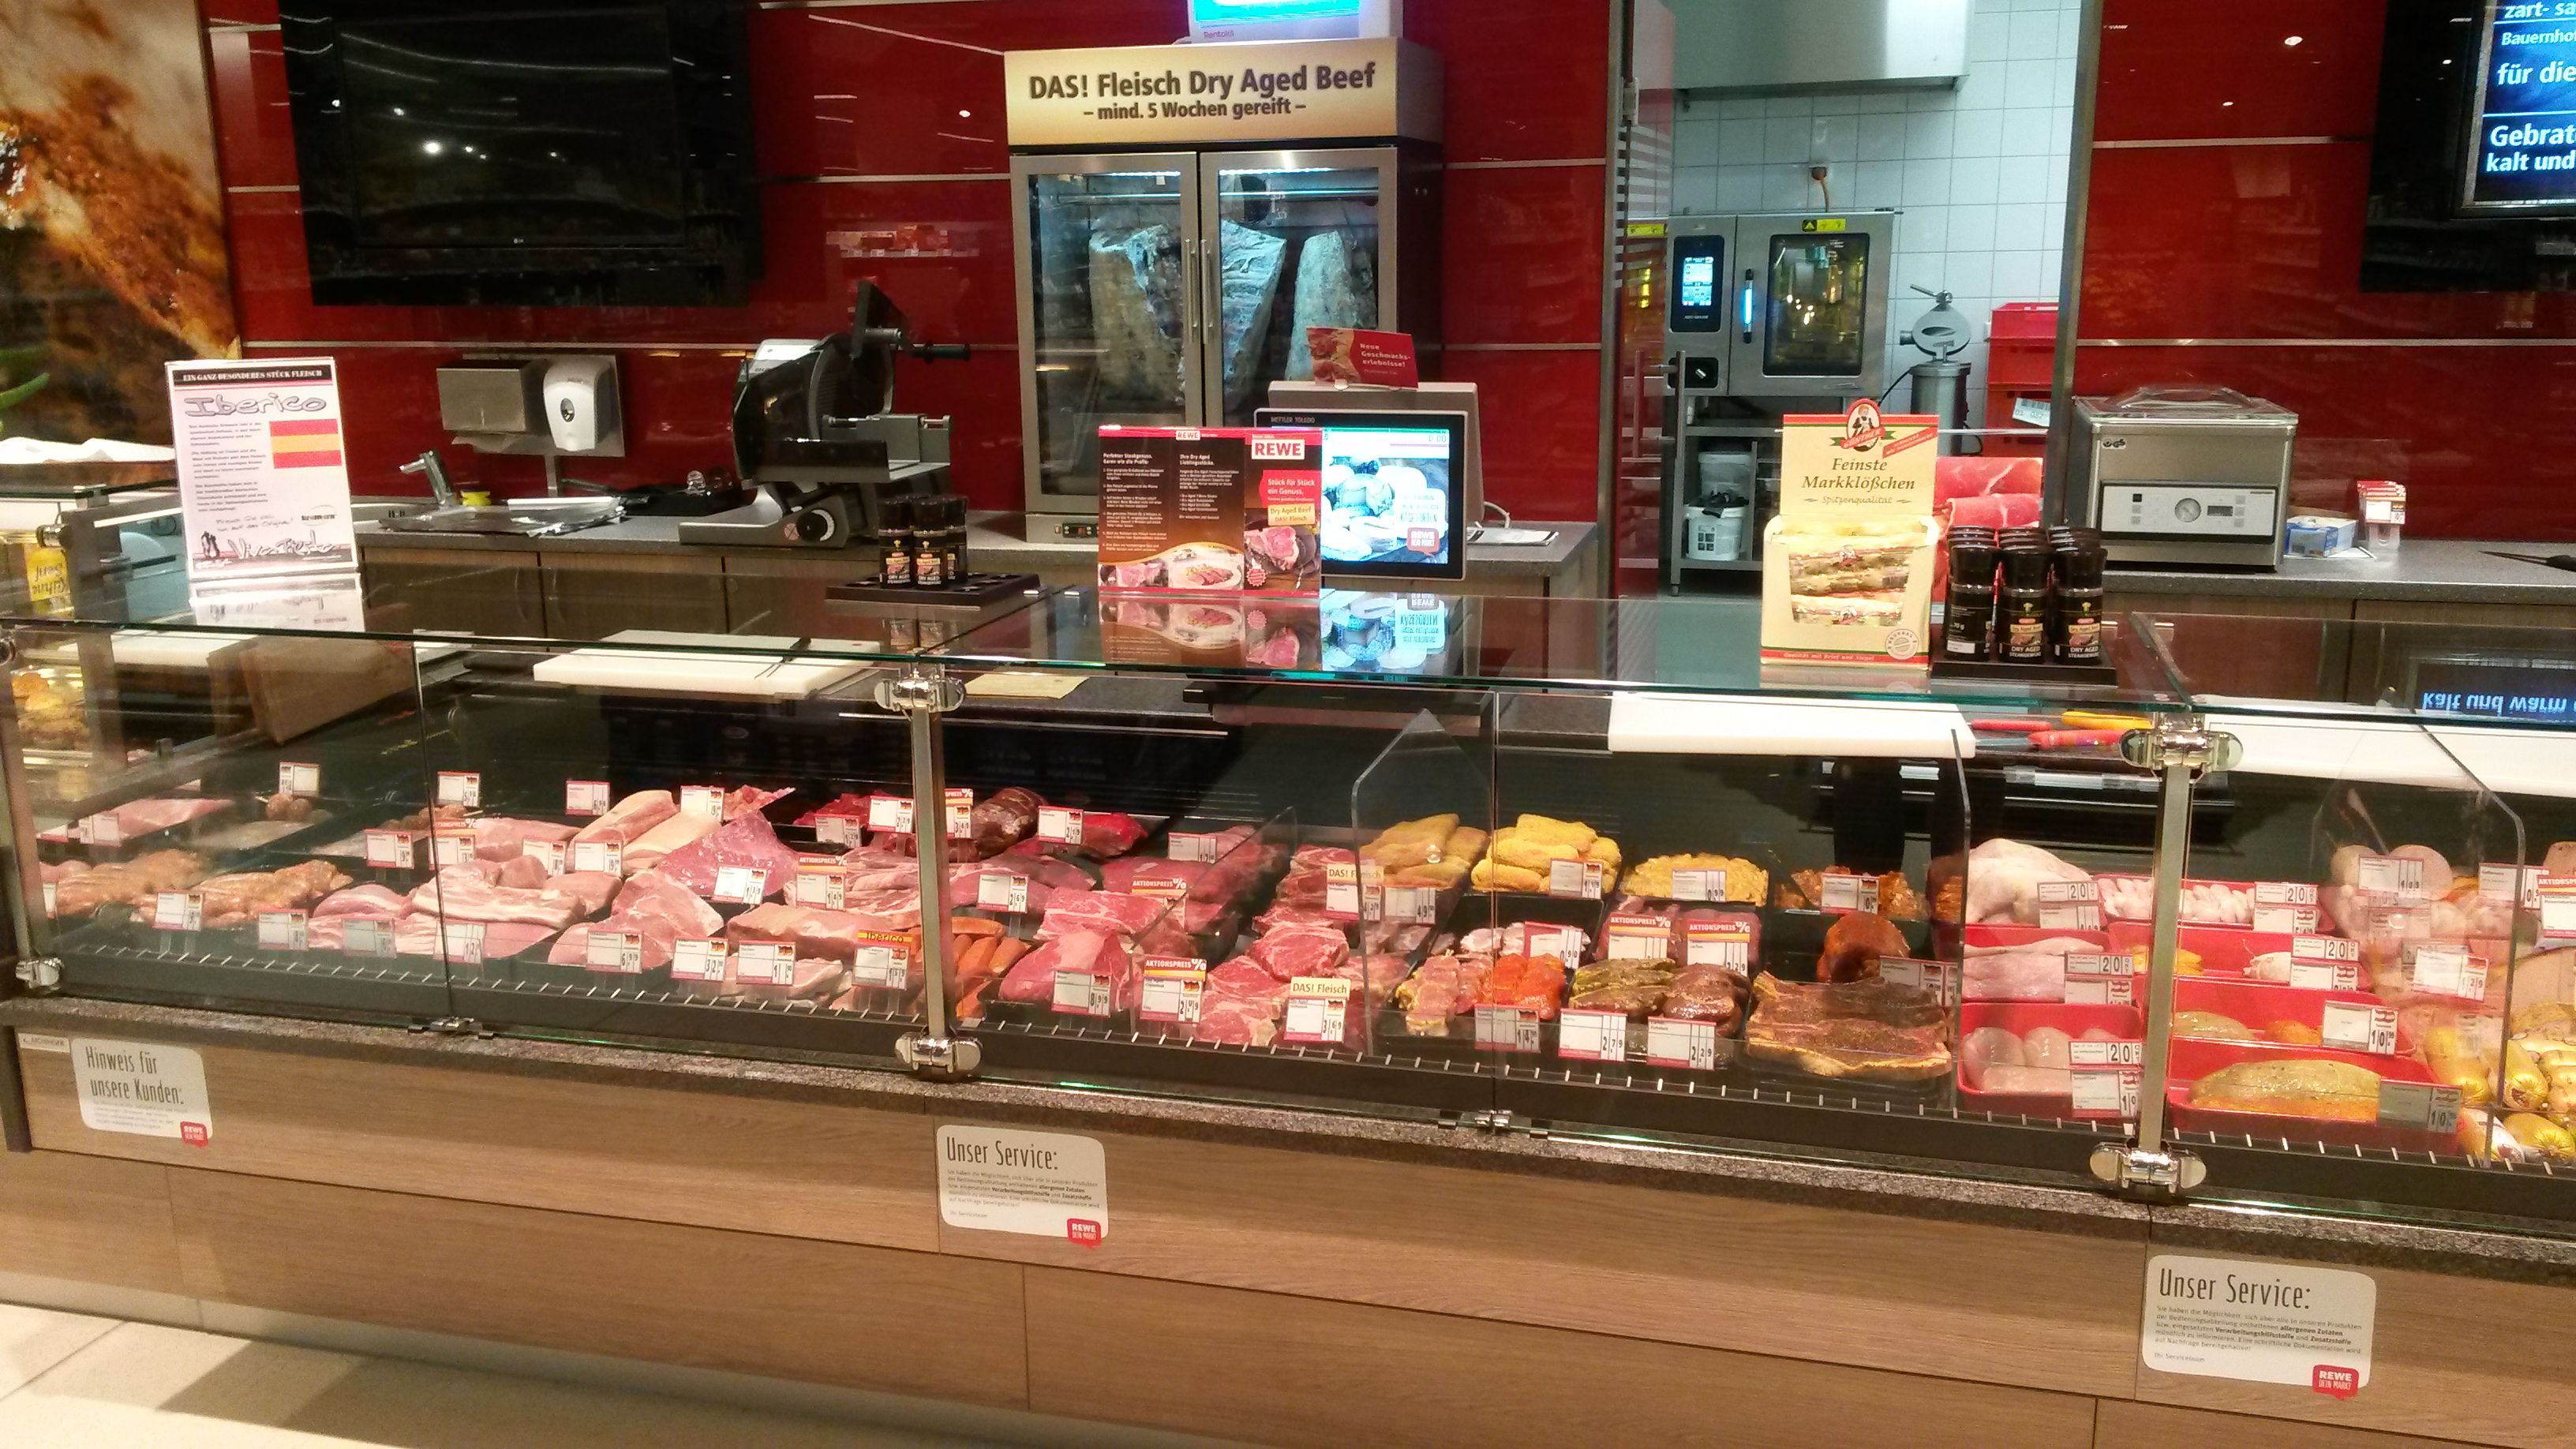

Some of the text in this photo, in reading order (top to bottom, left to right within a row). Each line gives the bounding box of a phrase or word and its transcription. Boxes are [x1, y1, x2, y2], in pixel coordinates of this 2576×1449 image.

[2504, 2, 2550, 19] zart-
[2501, 29, 2576, 46] Bauernho
[1029, 62, 1376, 99] DAS! Fleisch Dry Aged Beef
[2497, 61, 2576, 85] für die
[1098, 98, 1291, 120] mind. 5 Wochen gereift
[2490, 123, 2576, 147] Gebrat
[2487, 150, 2576, 172] kalt und
[218, 371, 265, 380] BESONDERES
[267, 369, 290, 379] STÜCK
[184, 392, 327, 417] Iberico
[1255, 443, 1301, 456] REWE
[1831, 457, 1888, 471] Feinste
[1297, 478, 1315, 487] Stück
[1802, 475, 1915, 492] Markklößchen
[1329, 868, 1348, 877] DAS!
[1133, 879, 1173, 888] AKTIONSPREIS
[2071, 884, 2086, 899] 20
[2288, 887, 2305, 901] 20
[1611, 917, 1656, 927] AKTIONSPREIS
[2328, 942, 2346, 958] 20
[1145, 960, 1191, 968] AKTIONSPREIS
[2103, 957, 2120, 972] 20
[1293, 983, 1346, 994] DAS! Fleisch
[85, 1046, 158, 1074] Hinweis für
[2110, 1044, 2130, 1062] 20
[90, 1078, 130, 1099] unsere
[946, 1136, 1058, 1170] Unser Service:
[1072, 1223, 1096, 1233] REWE
[2160, 1267, 2311, 1310] Unser Service:
[2279, 1325, 2316, 1334] allergenen
[2310, 1335, 2352, 1345] Zusatzstoffe
[2319, 1369, 2352, 1382] REWE
[2333, 1380, 2352, 1391] MARKT
